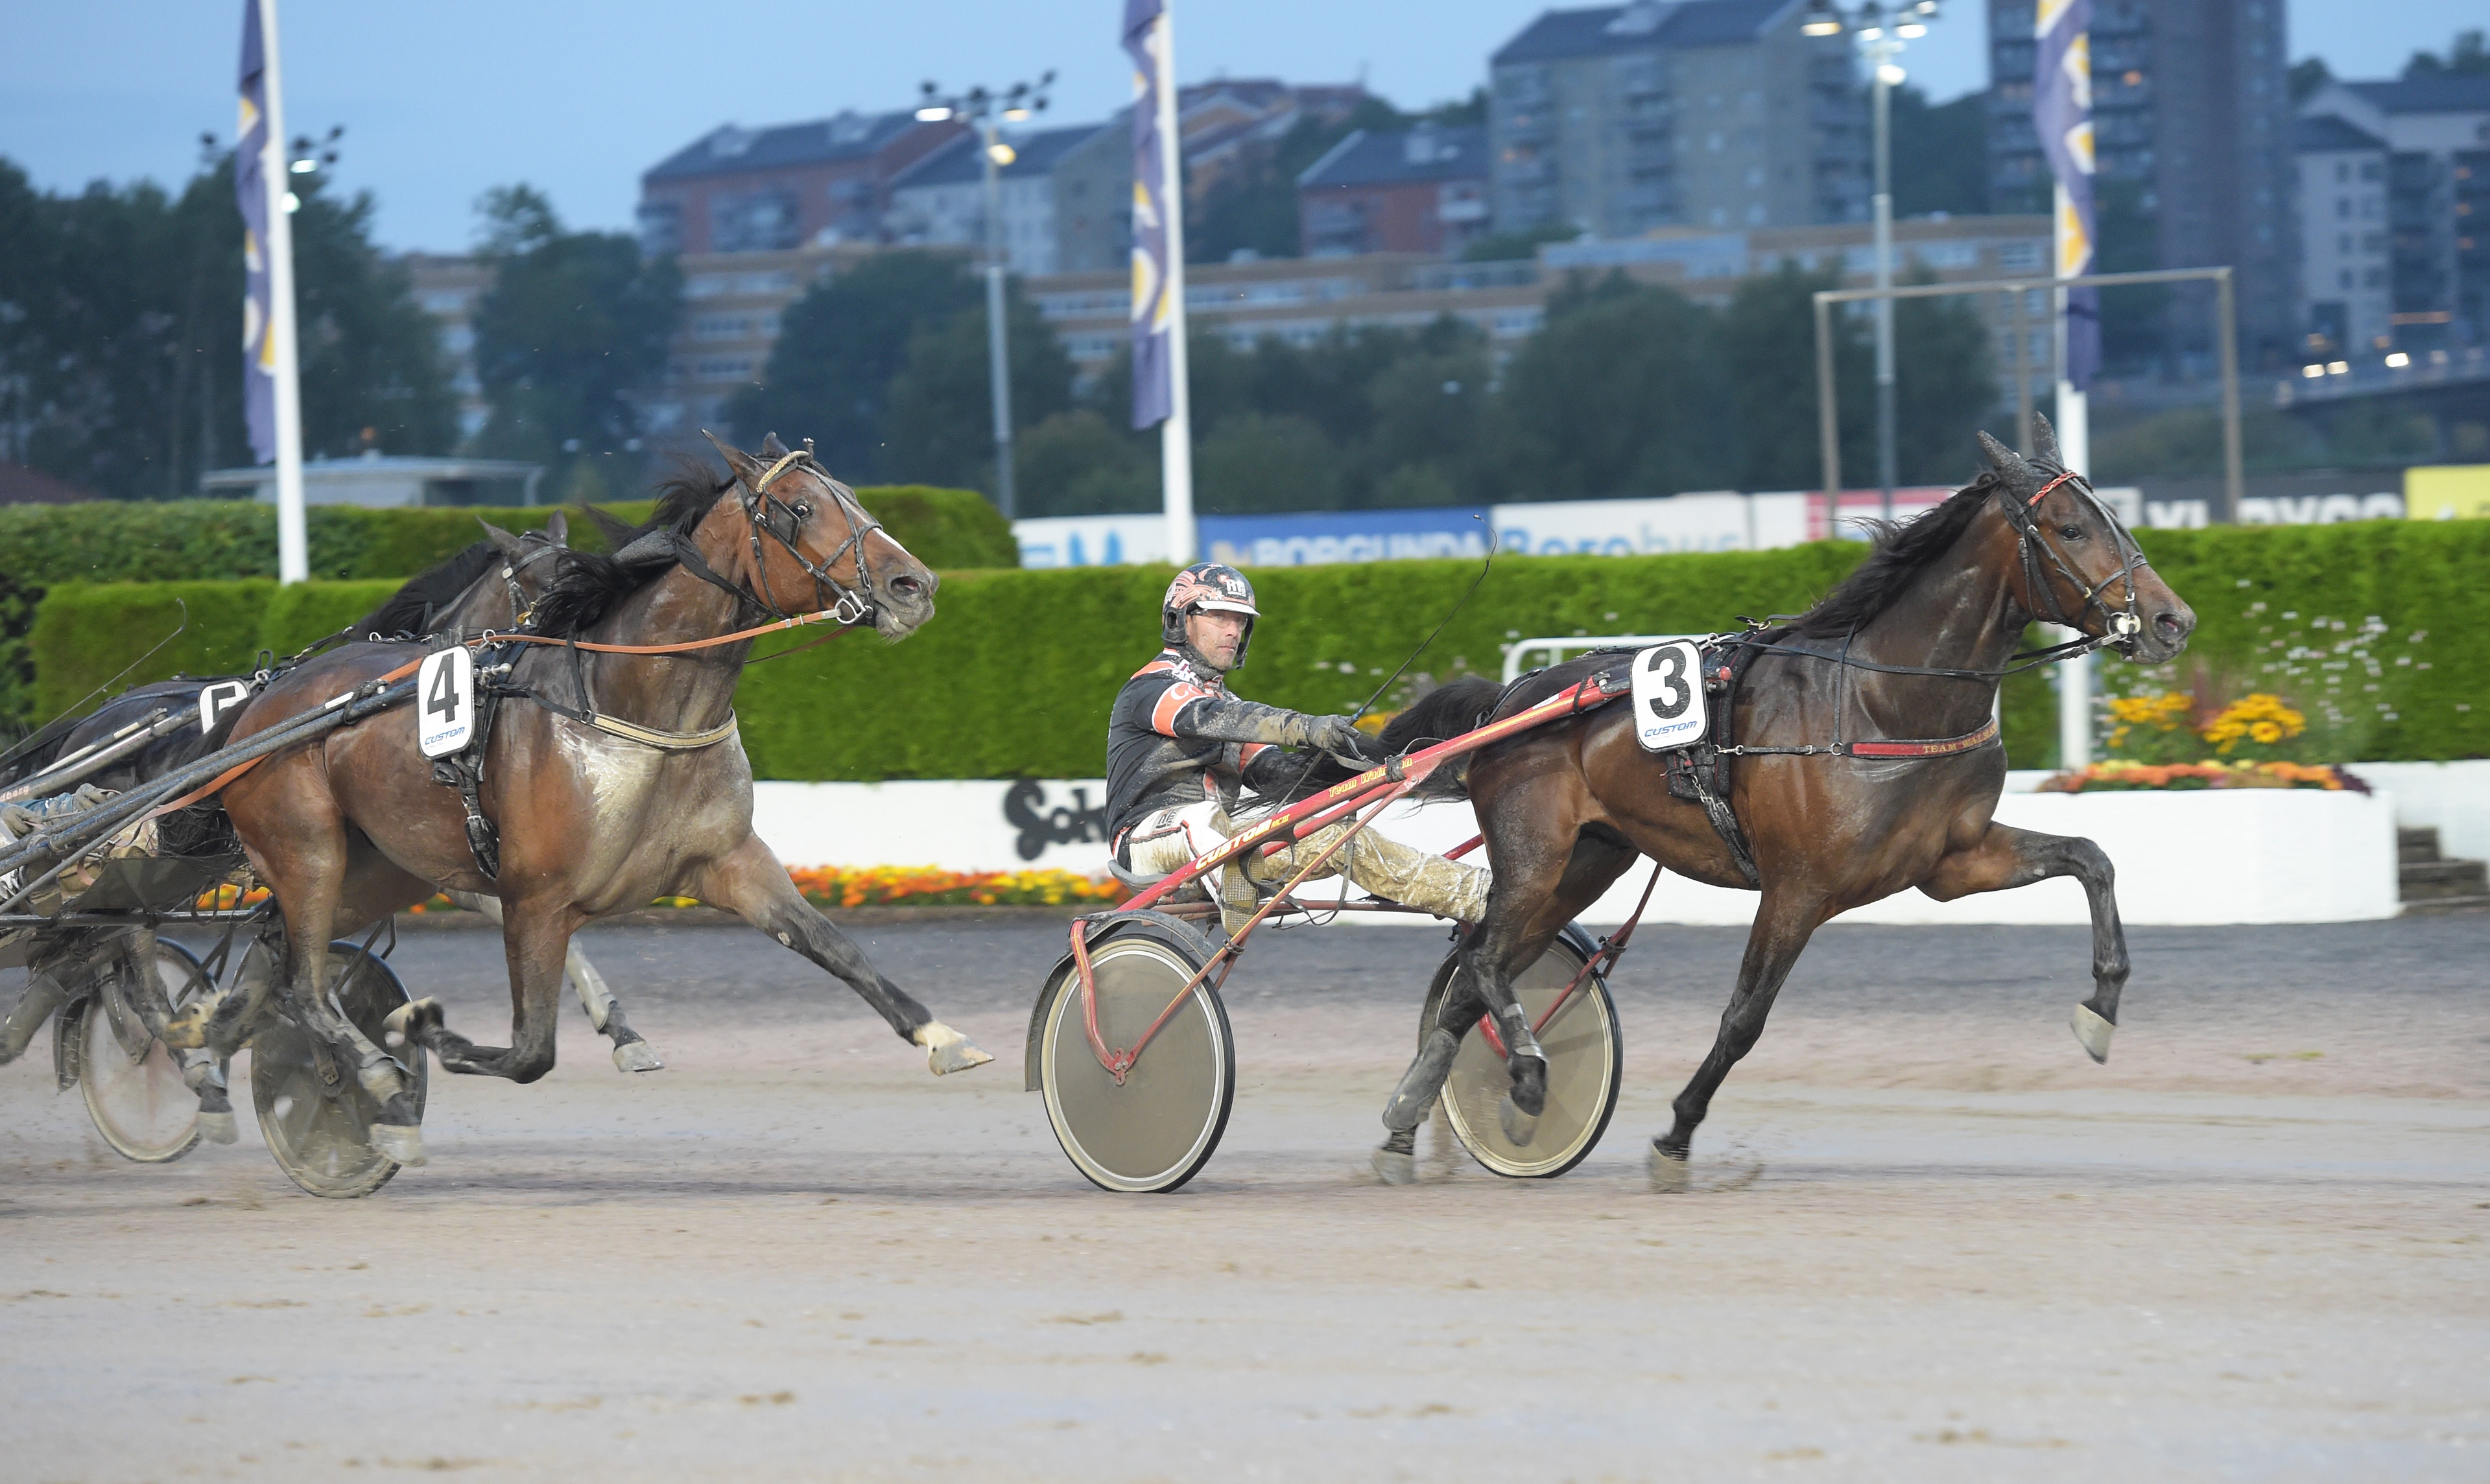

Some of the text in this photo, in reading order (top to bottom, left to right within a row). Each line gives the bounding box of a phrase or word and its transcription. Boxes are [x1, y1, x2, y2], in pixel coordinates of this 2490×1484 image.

[427, 652, 460, 724] 4
[1648, 646, 1691, 720] 3
[425, 726, 466, 746] CUSTOM
[1644, 720, 1698, 738] CUSTOM
[1923, 743, 1958, 753] TEAM
[1329, 779, 1357, 798] Team
[1195, 818, 1273, 870] CUSTOM
